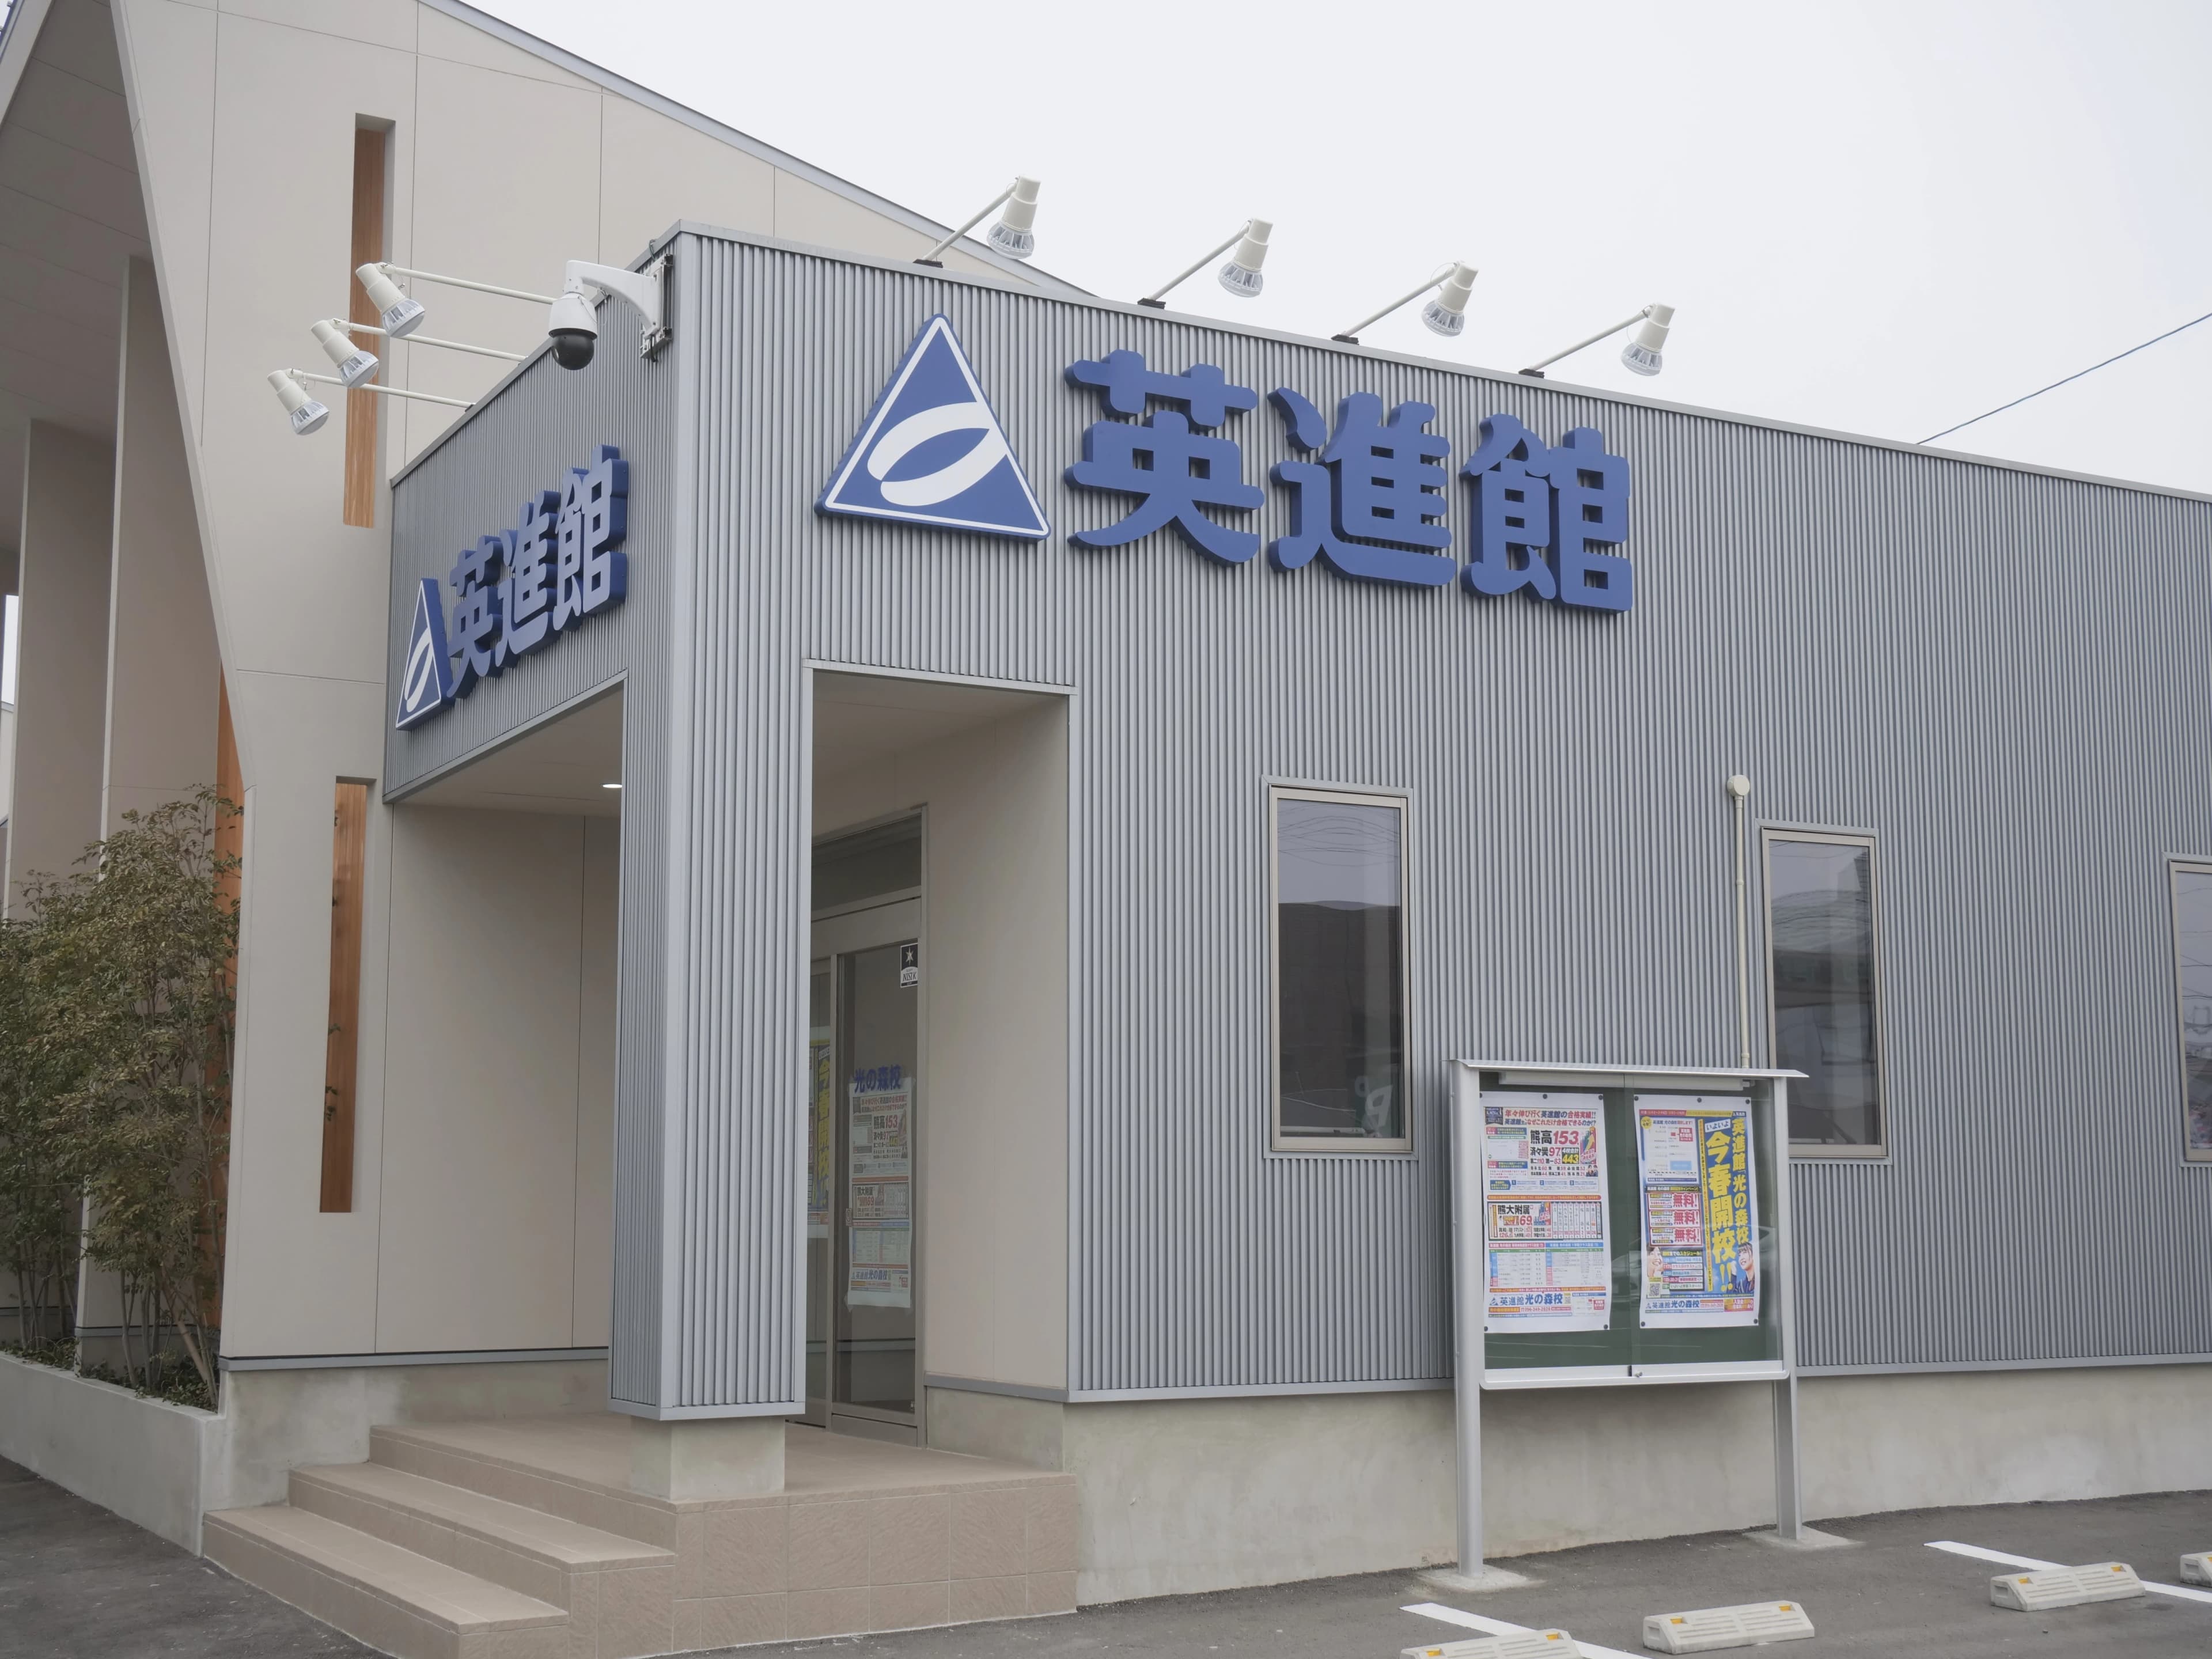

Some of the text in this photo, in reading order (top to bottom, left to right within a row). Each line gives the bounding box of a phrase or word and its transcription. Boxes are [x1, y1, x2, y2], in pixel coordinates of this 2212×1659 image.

[1065, 349, 1633, 613] 英進館
[447, 444, 628, 699] 英進館
[855, 1065, 901, 1093] 光の森校
[1706, 1120, 1729, 1130] いよいよ
[1530, 1130, 1552, 1145] 熊高
[1553, 1131, 1579, 1145] 153
[1498, 1205, 1530, 1214] 熊大附属
[1499, 1293, 1563, 1306] 英進館 光の森校
[1671, 1300, 1700, 1308] 光の森校
